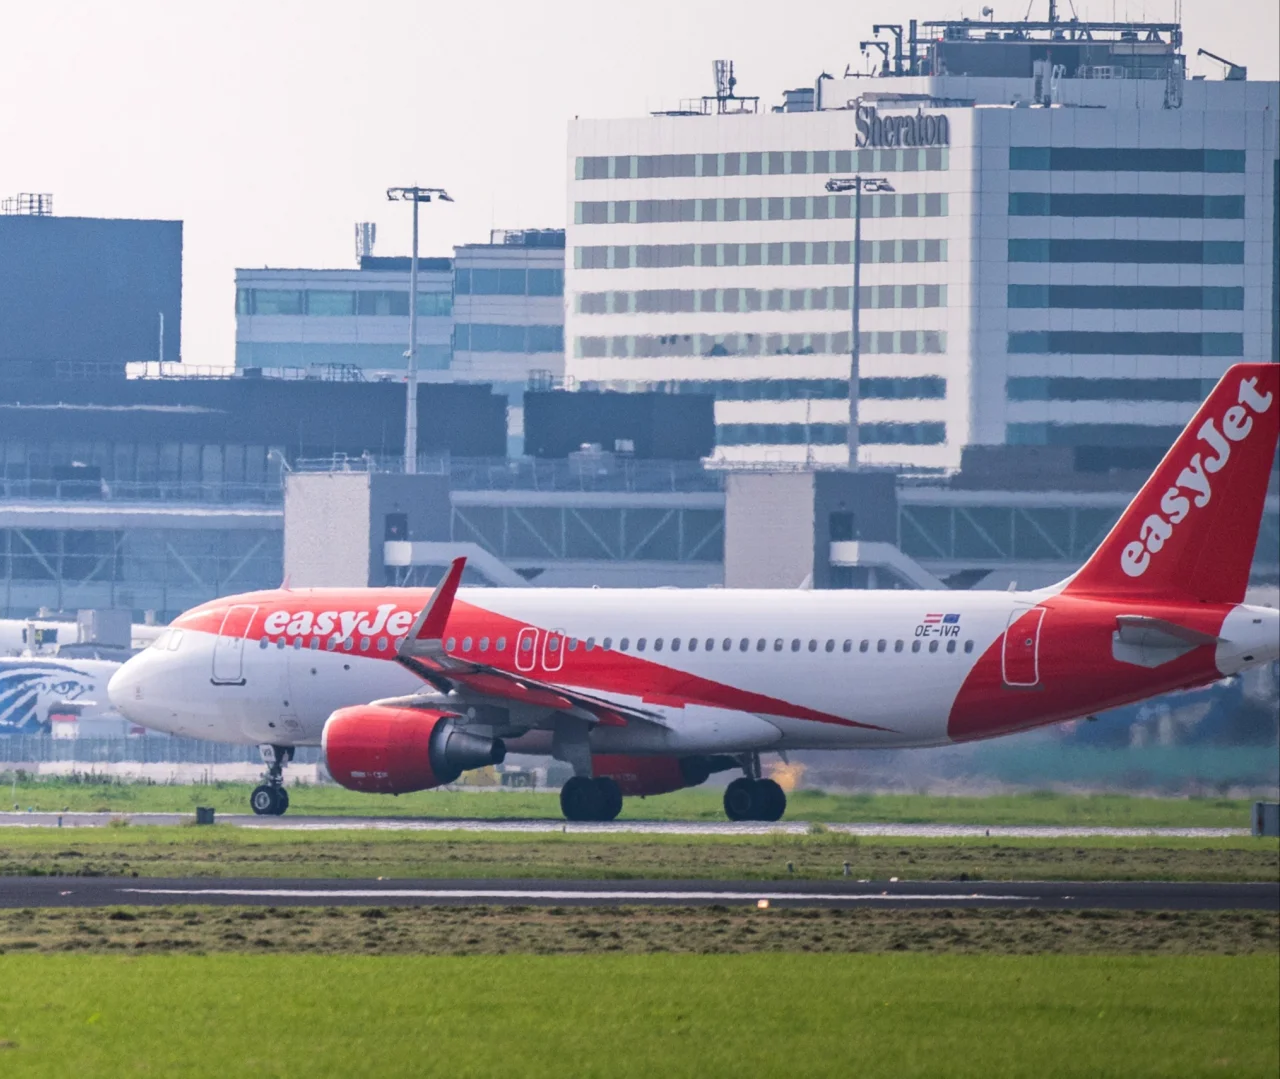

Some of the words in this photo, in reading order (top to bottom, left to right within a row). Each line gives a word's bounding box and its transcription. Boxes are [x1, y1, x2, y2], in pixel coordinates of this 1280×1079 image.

[855, 106, 949, 148] Sheraton
[1120, 376, 1273, 577] easyJet
[914, 625, 961, 637] OE-IVR
